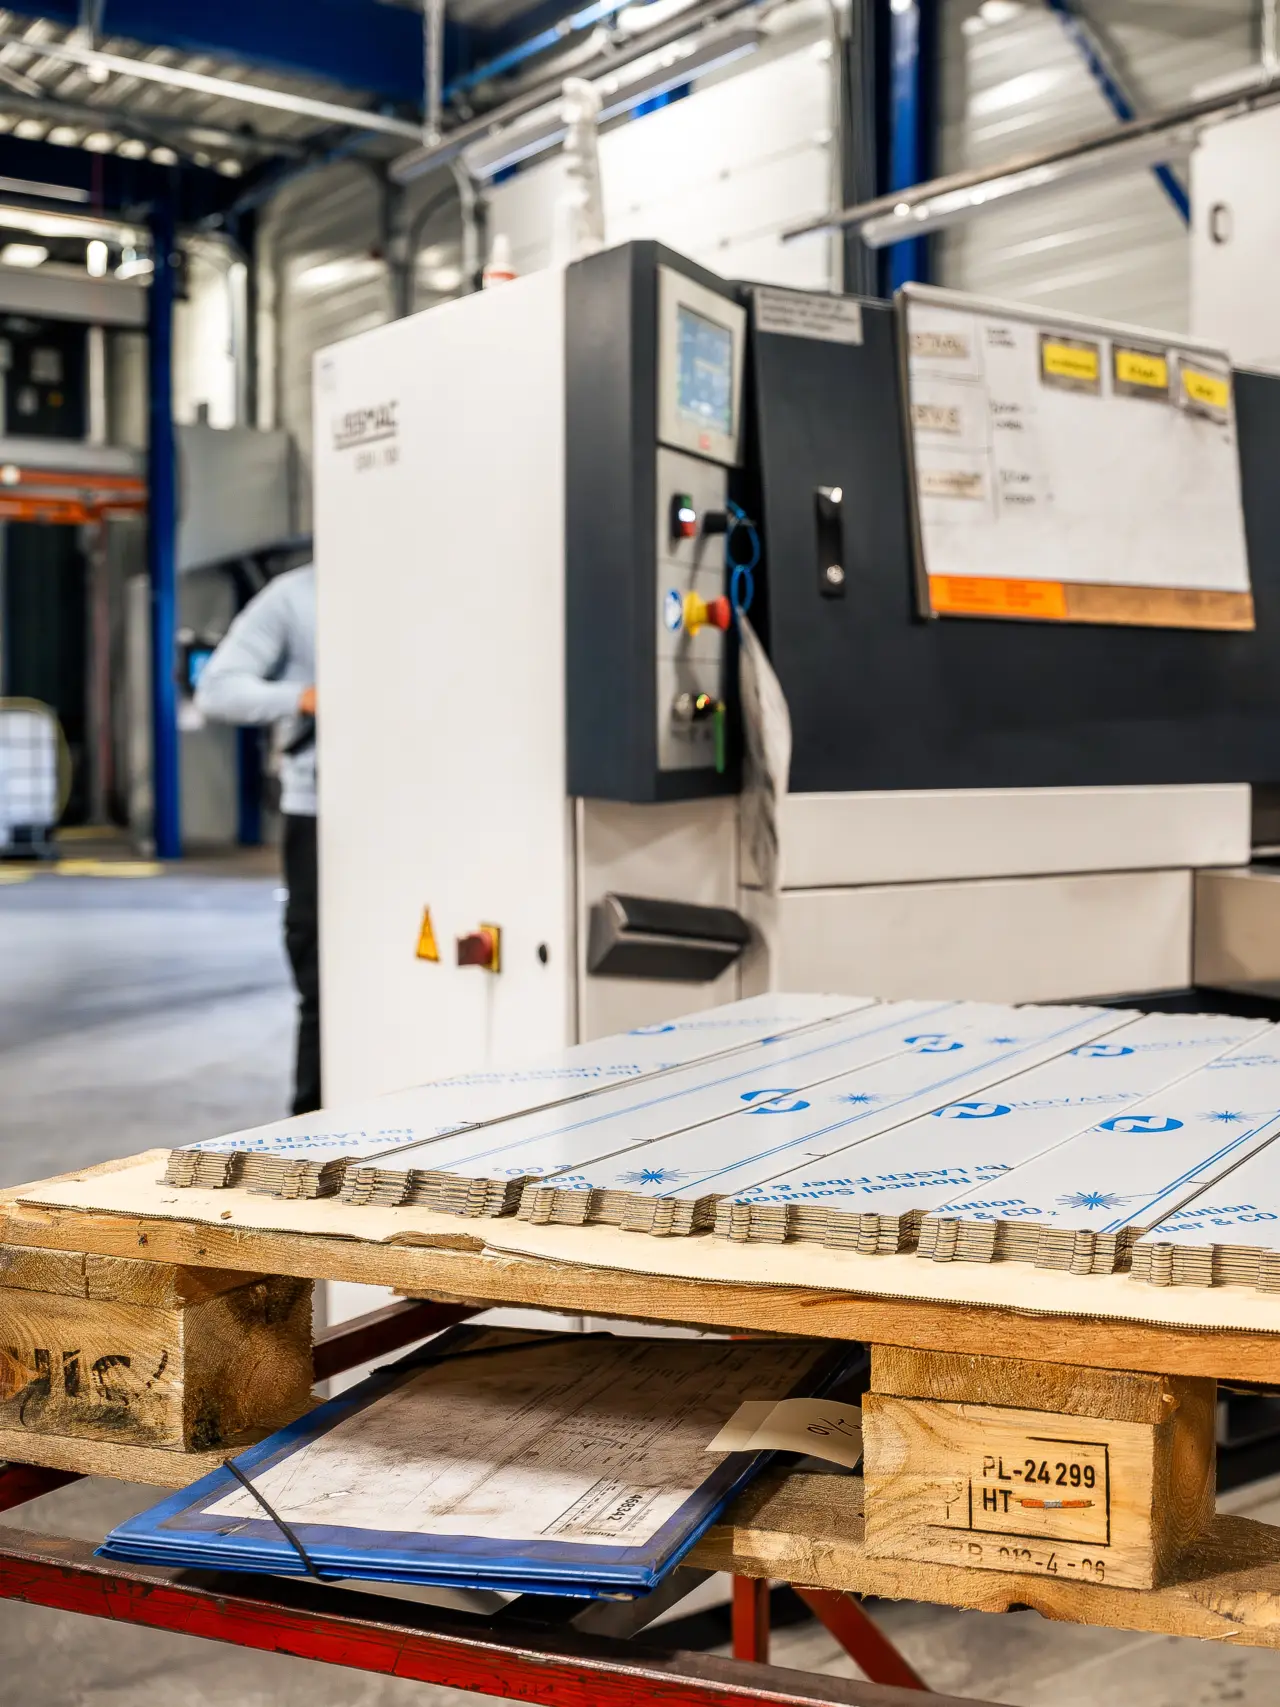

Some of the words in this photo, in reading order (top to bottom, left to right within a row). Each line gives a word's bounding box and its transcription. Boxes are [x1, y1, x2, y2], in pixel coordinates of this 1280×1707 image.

[801, 1176, 871, 1190] Fiber
[875, 1167, 967, 1181] LASER
[862, 1176, 970, 1194] Novacel
[733, 1187, 855, 1205] Solution
[1210, 1217, 1236, 1226] &
[605, 1494, 644, 1521] 468342
[982, 1488, 1013, 1513] HT
